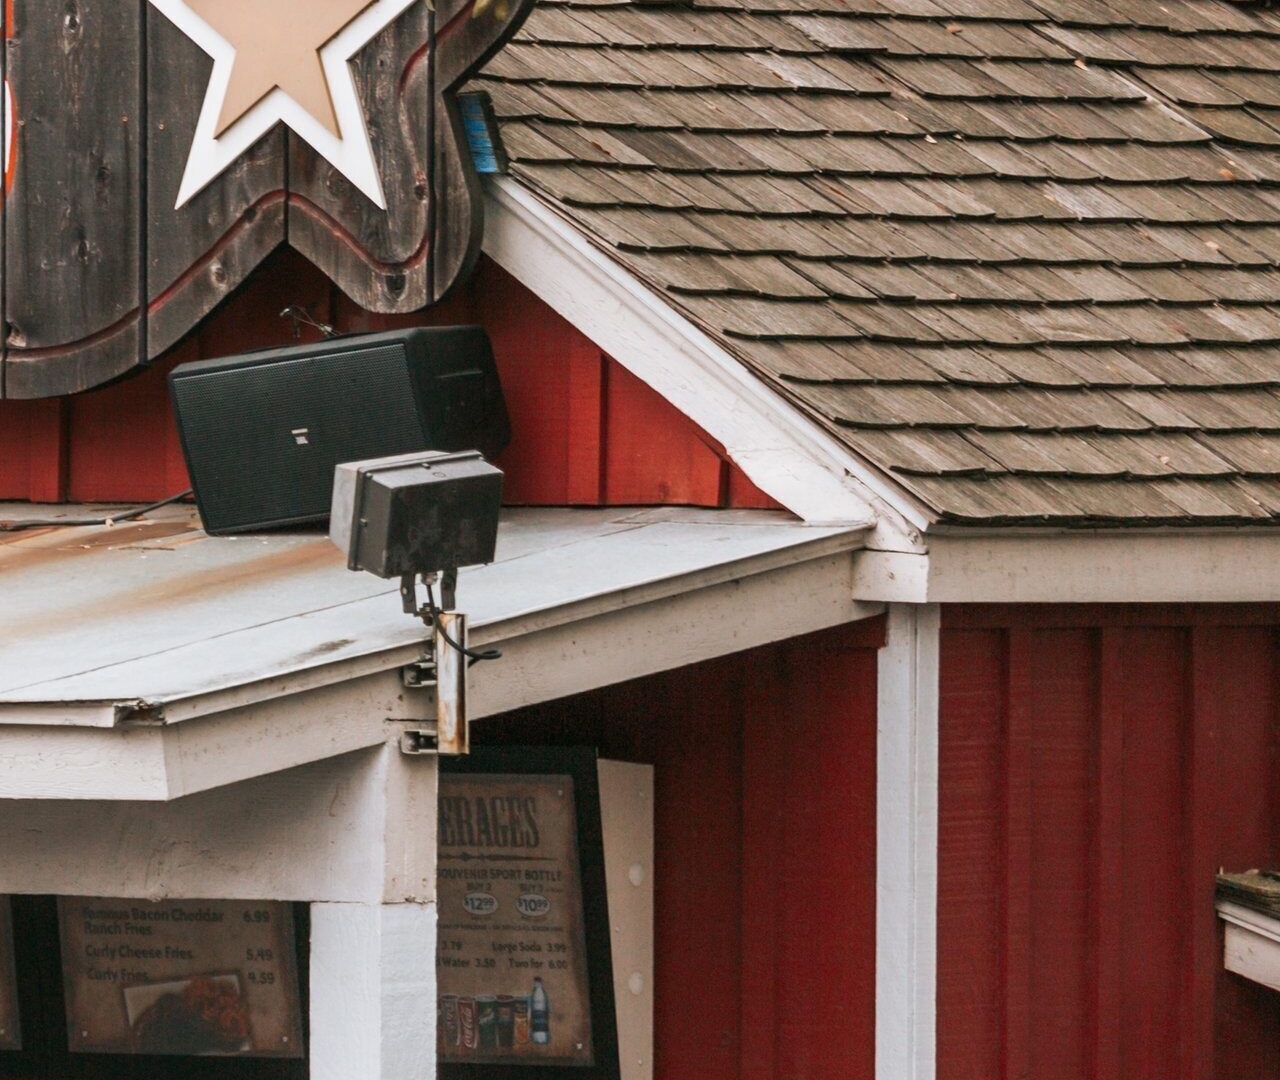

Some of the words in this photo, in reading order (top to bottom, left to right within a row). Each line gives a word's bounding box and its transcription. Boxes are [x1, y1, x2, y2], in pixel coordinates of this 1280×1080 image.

[439, 796, 539, 847] ERAGES
[490, 869, 522, 880] SPORT
[525, 870, 562, 881] BOTTLE
[132, 907, 168, 921] Bacon
[171, 908, 223, 922] Cheddar
[84, 921, 121, 934] Ranch
[85, 944, 116, 959] Curly
[118, 944, 162, 959] Cheese
[165, 946, 194, 960] Fries
[519, 941, 542, 952] Soda
[88, 968, 119, 982] Curly
